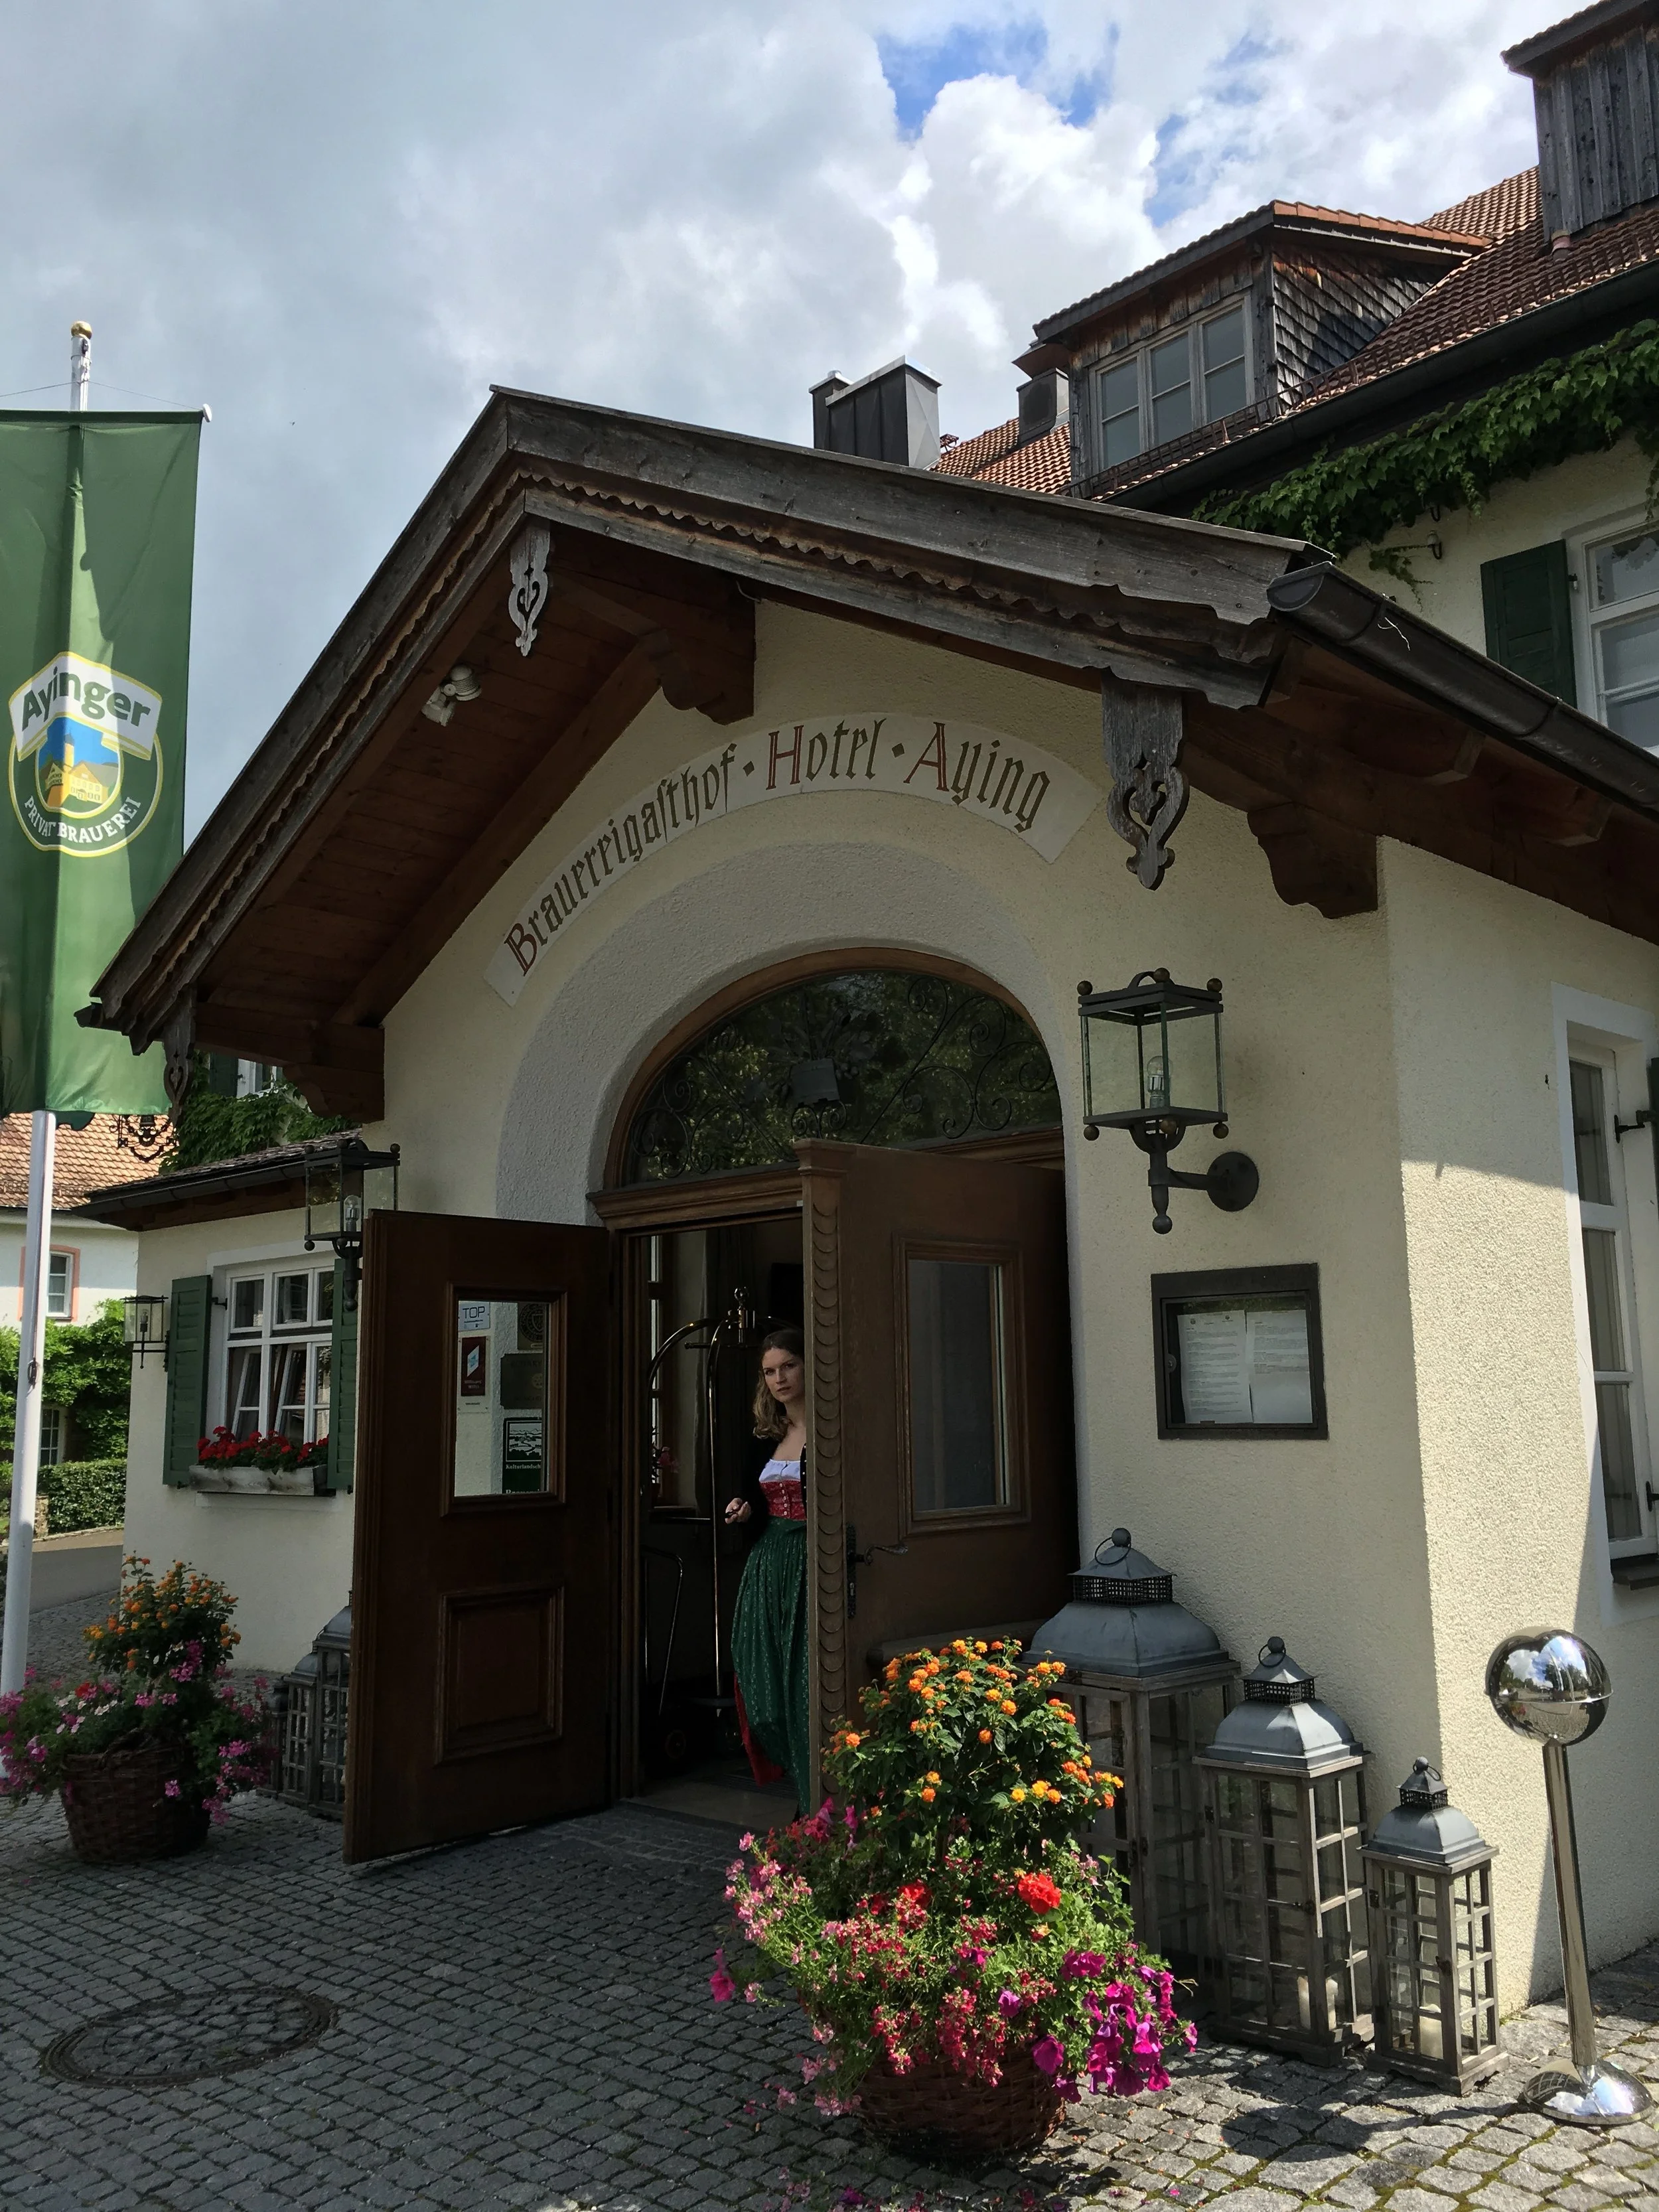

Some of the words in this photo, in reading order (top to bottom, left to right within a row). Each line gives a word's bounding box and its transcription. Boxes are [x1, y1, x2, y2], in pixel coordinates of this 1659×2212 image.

[22, 666, 151, 732] Ayinger
[766, 718, 887, 790] Hotel
[903, 722, 1050, 833] Aying
[463, 1306, 485, 1319] TOP
